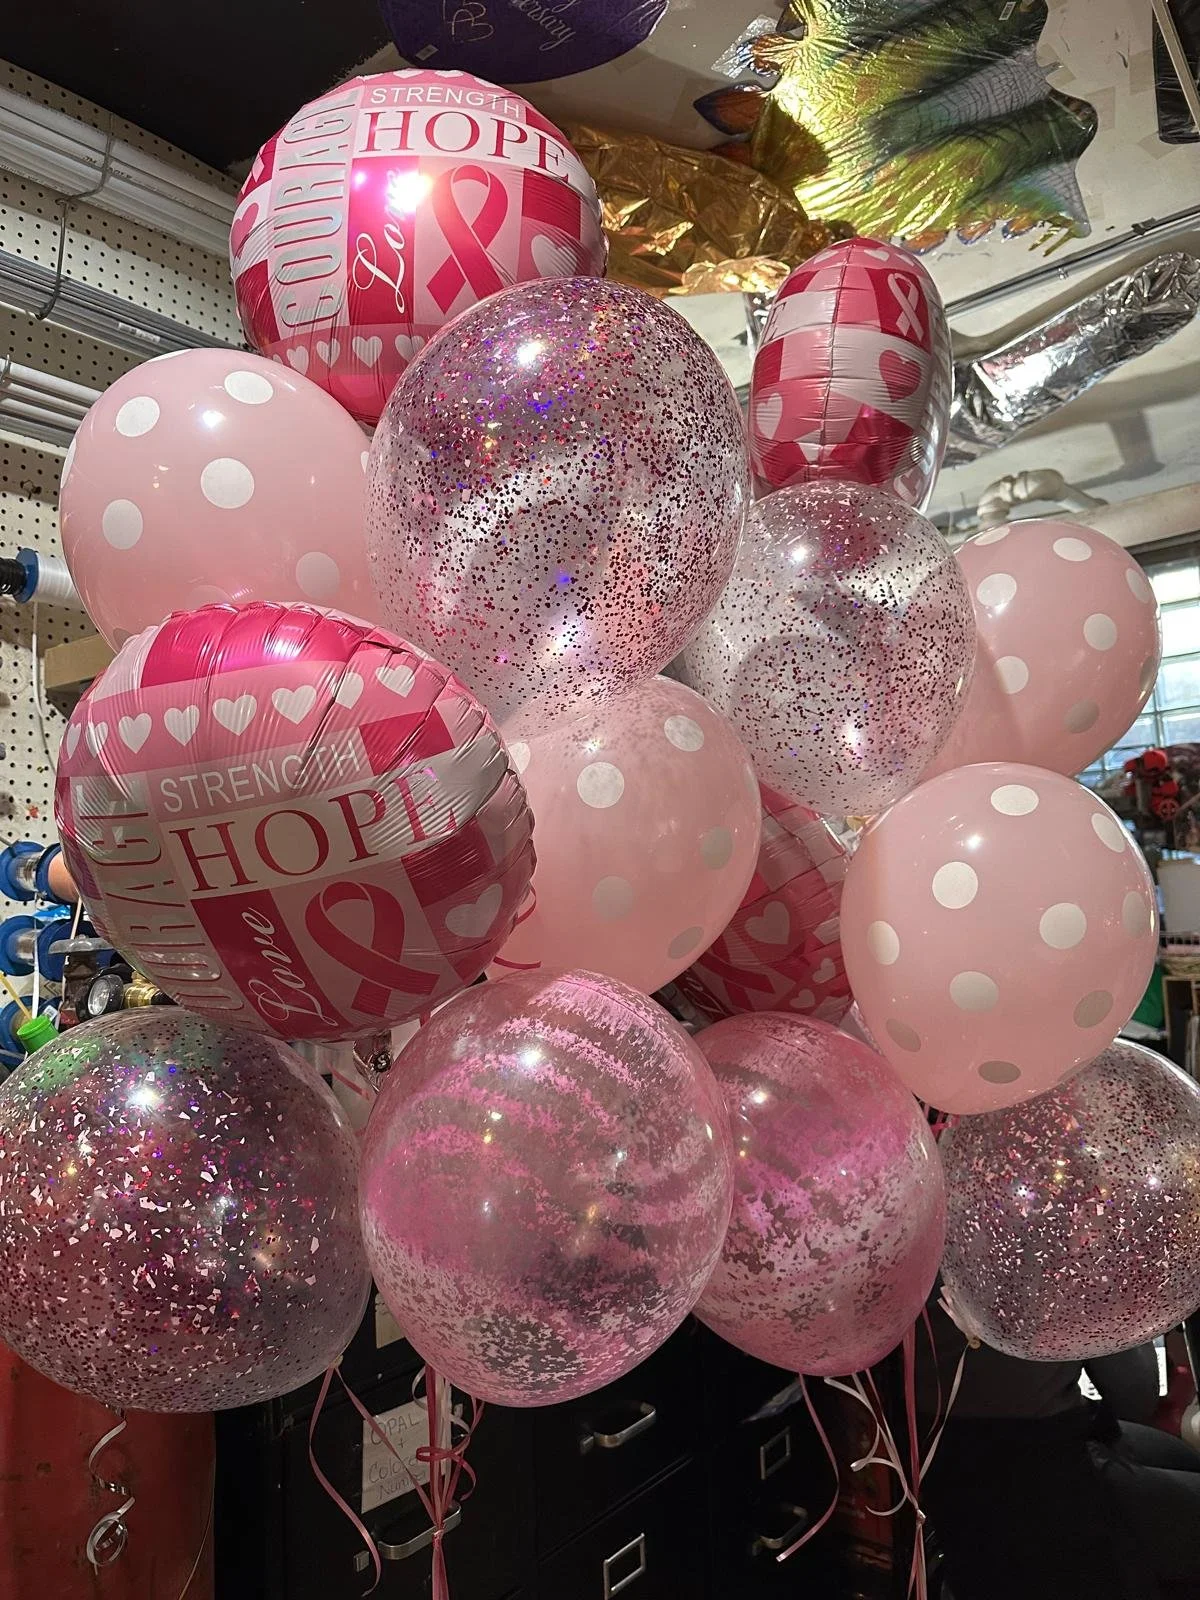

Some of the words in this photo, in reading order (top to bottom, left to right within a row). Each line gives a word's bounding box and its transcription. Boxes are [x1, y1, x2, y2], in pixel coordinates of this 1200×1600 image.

[511, 0, 577, 51] ersary
[358, 110, 569, 184] HOPE
[370, 86, 519, 119] STRENGTH
[273, 89, 358, 328] COURAGE
[352, 168, 406, 314] Lo
[160, 739, 361, 813] STRENGTH
[169, 769, 458, 892] HOPE
[76, 784, 266, 1032] OURAGE
[248, 907, 339, 1028] Love
[370, 1413, 420, 1445] OPAL
